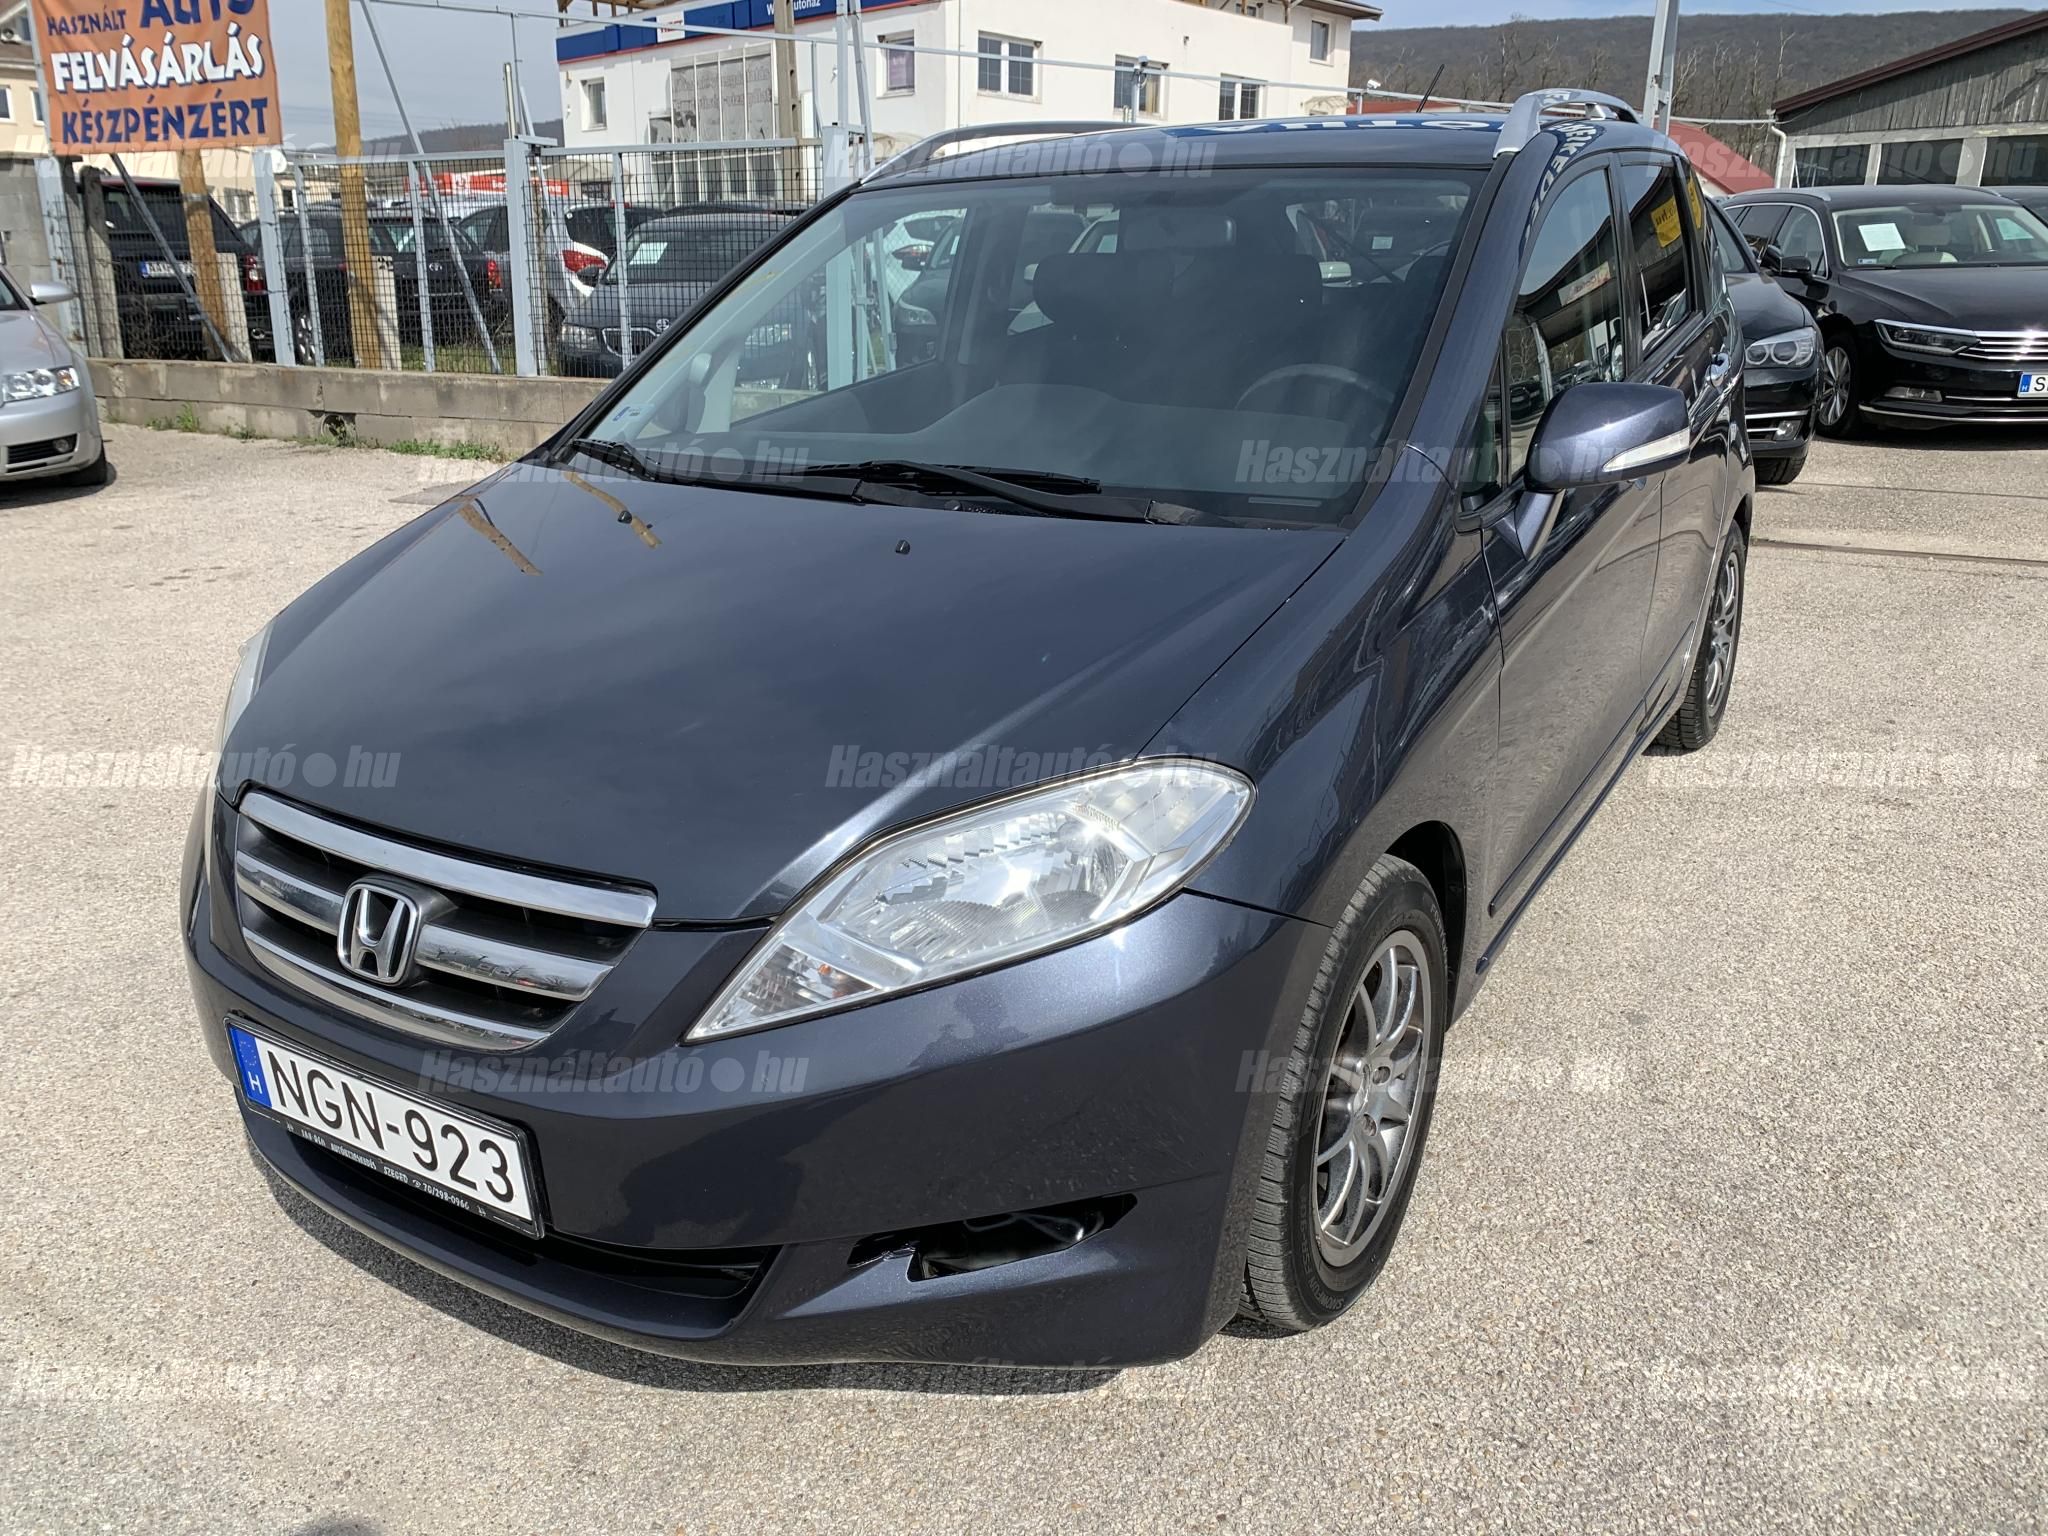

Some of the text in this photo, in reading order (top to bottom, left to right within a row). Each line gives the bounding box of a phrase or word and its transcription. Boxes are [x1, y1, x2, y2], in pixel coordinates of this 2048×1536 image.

[48, 4, 127, 36] HASZNÁLT
[51, 21, 265, 94] FELVÁSÁRLÁS
[62, 89, 268, 144] KÉSZPÉNZÉRT
[2033, 376, 2048, 392] S
[266, 1049, 515, 1204] NGN-923
